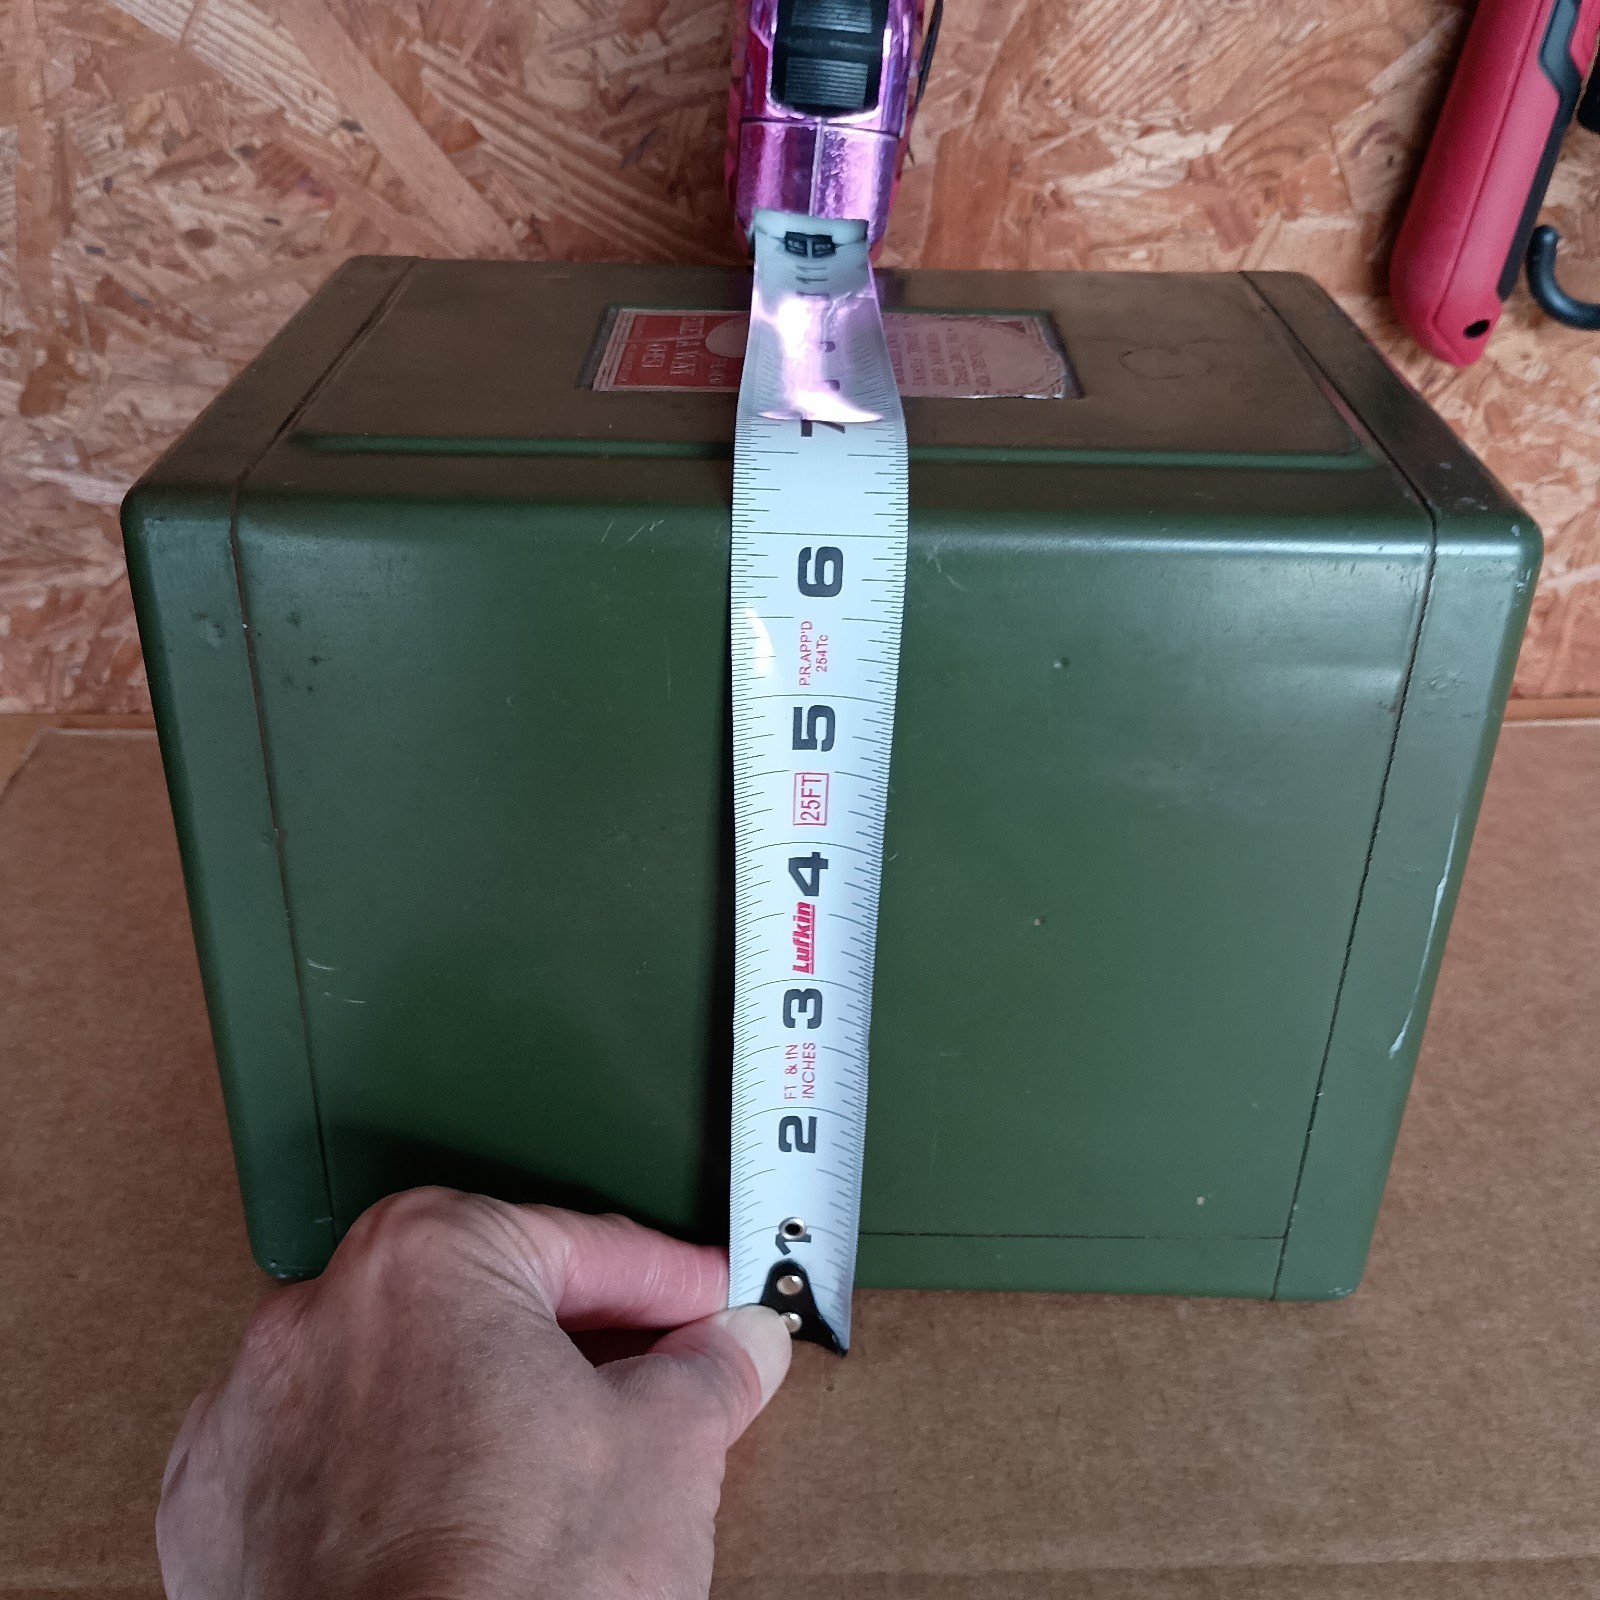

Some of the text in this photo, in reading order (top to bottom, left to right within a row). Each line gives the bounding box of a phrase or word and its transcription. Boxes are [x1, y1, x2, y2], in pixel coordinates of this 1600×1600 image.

[798, 547, 844, 598] 6
[793, 704, 836, 752] 5
[800, 774, 822, 822] 25FT
[788, 851, 829, 897] 4
[792, 901, 816, 975] Lufkin
[783, 988, 823, 1030] 3
[784, 1044, 799, 1100] FT & IN
[801, 1042, 816, 1099] INCHES
[779, 1115, 818, 1154] 2
[775, 1233, 812, 1256] 1
